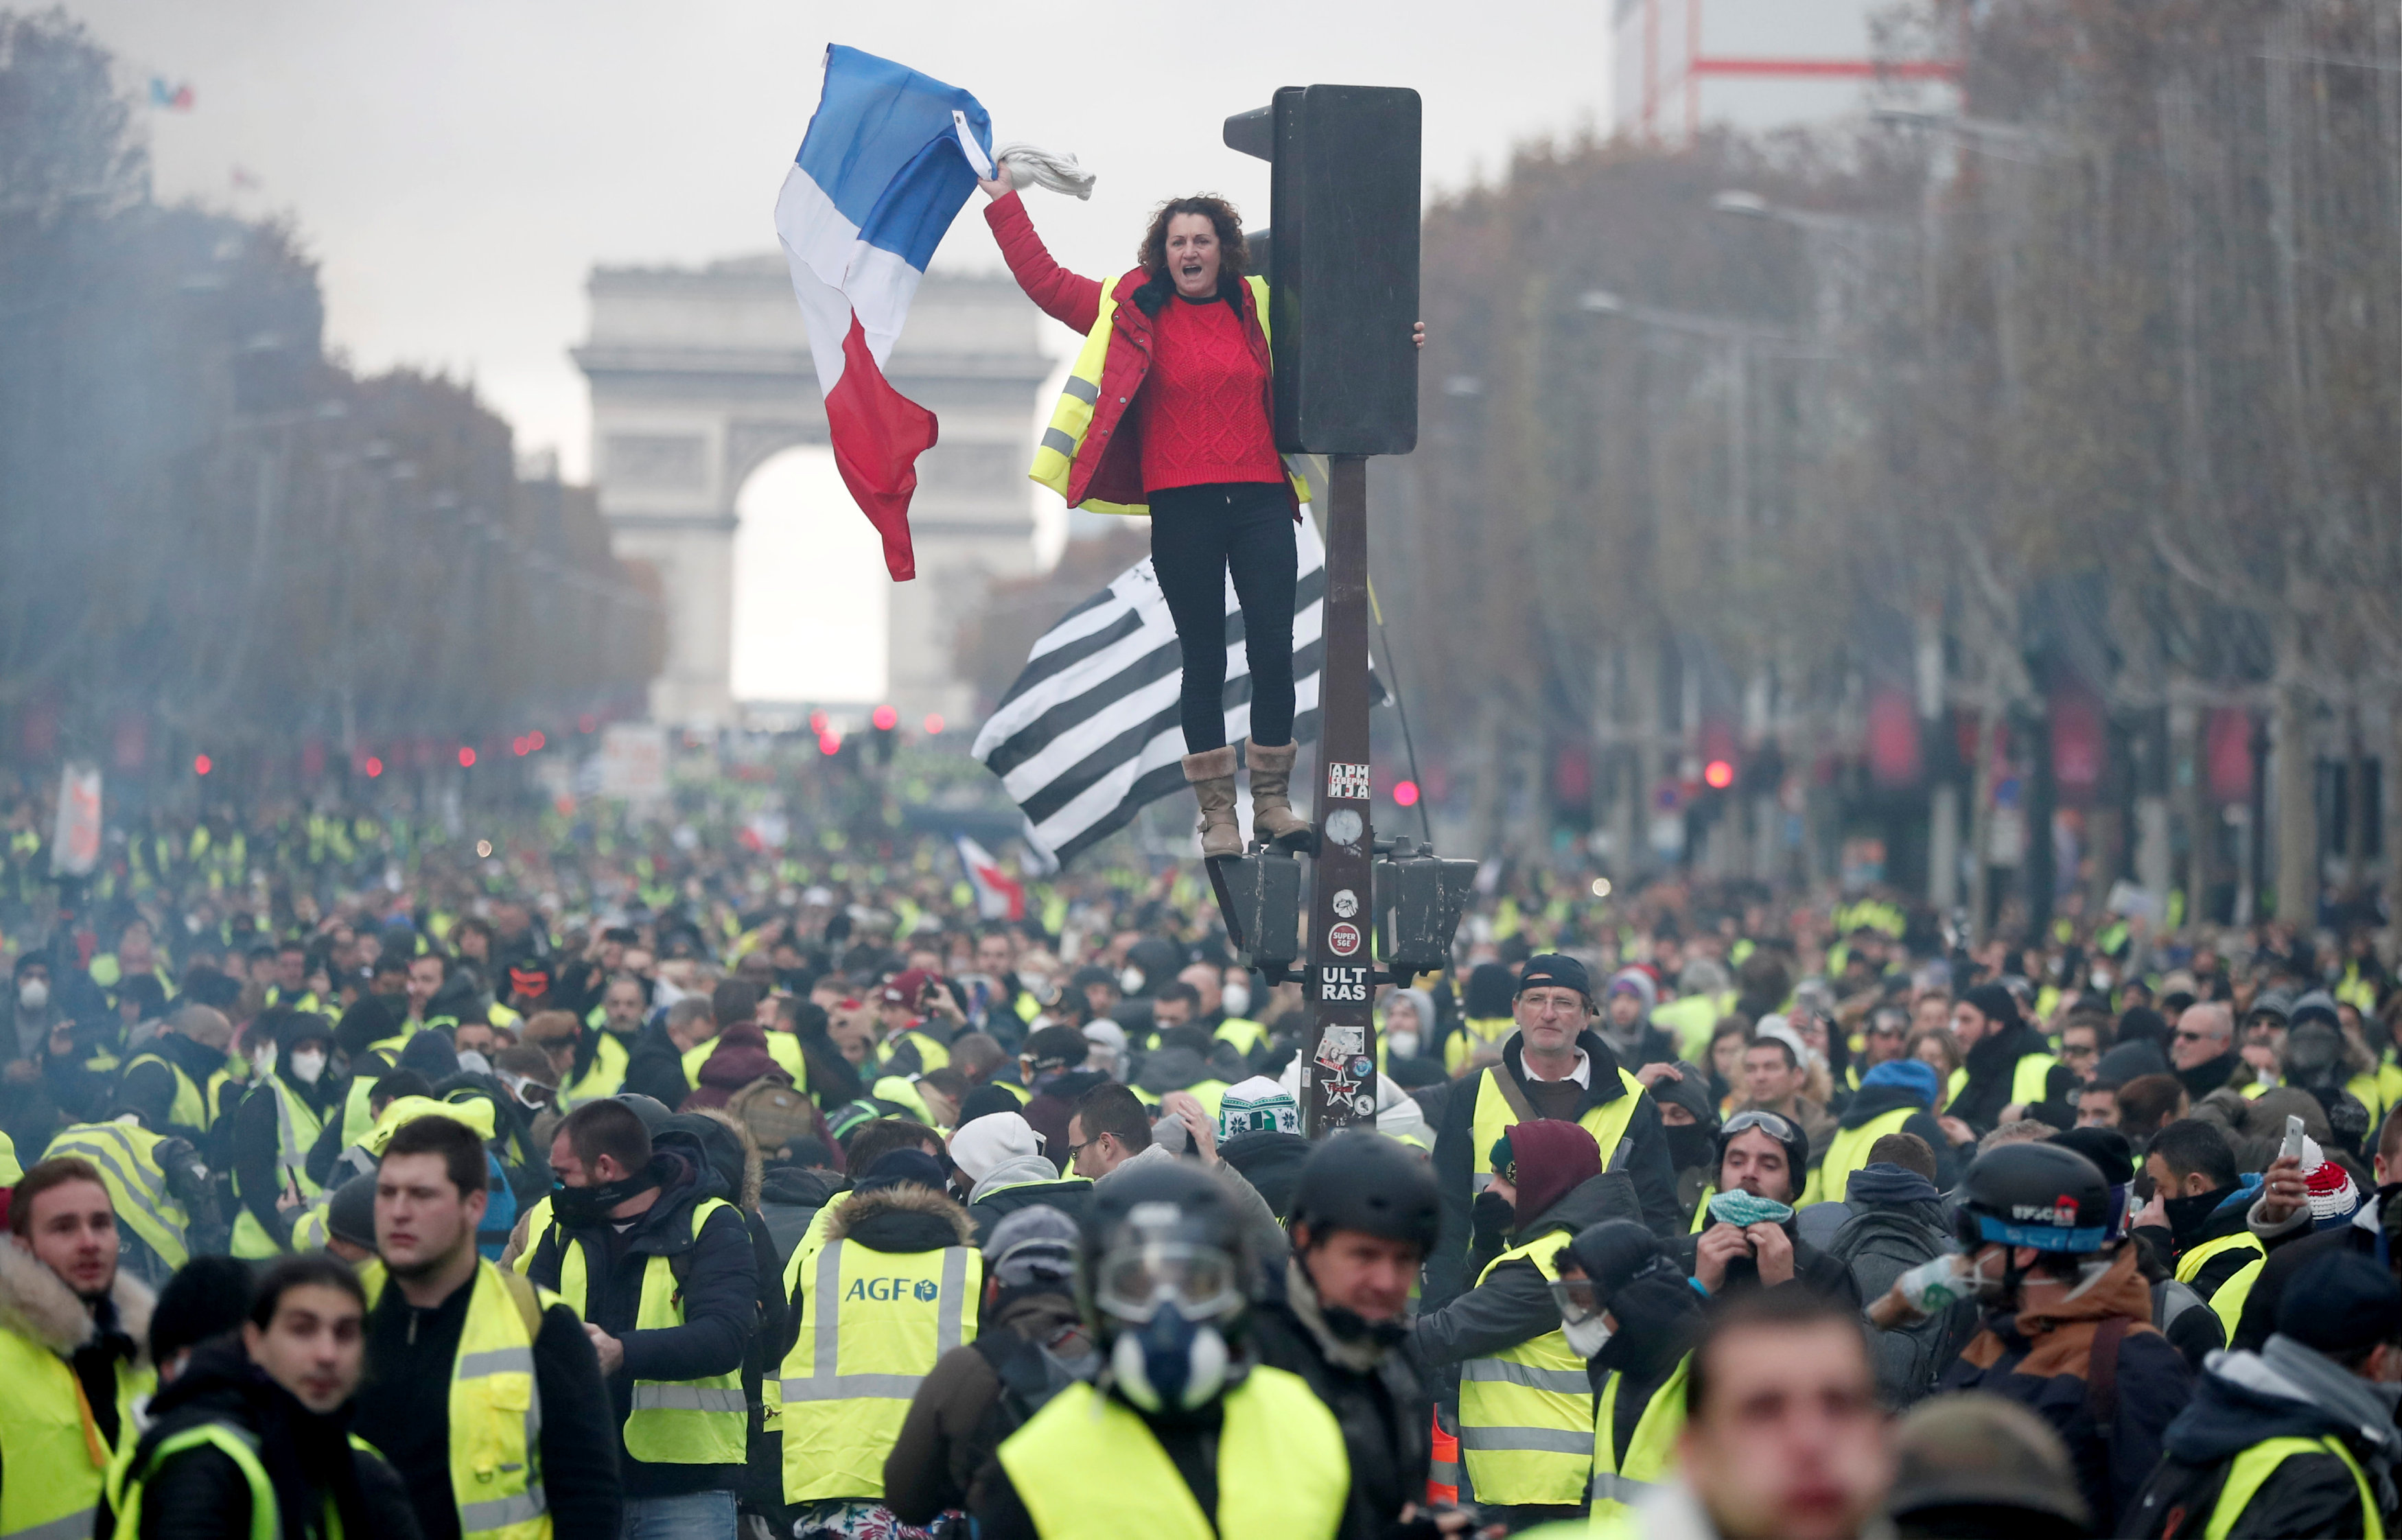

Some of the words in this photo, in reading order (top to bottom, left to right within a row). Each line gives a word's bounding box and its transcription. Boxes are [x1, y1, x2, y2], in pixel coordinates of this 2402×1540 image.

[1333, 931, 1356, 940] SUPER
[1322, 967, 1366, 983] ULT
[1322, 984, 1366, 1001] RAS
[845, 1277, 911, 1302] AGF
